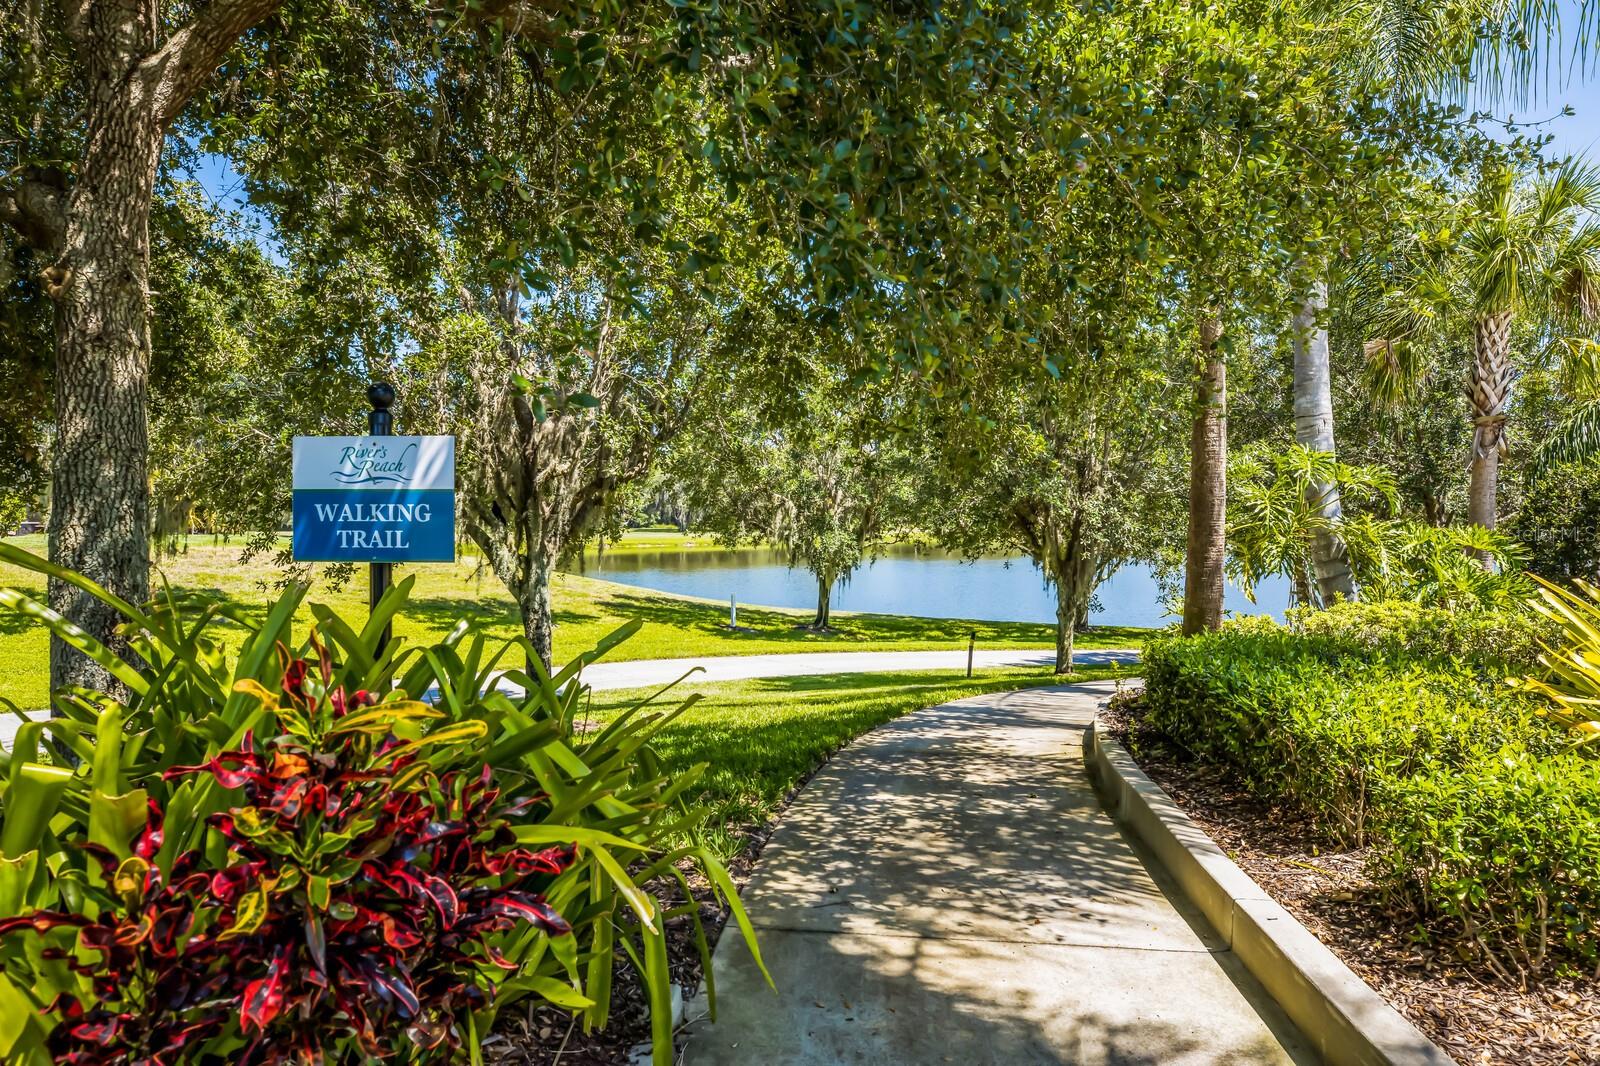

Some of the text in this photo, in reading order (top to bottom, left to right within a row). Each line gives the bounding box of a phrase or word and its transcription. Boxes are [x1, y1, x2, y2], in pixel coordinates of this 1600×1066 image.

[339, 443, 388, 470] River's
[358, 443, 417, 485] Reach
[314, 503, 432, 523] WALKING
[336, 529, 410, 549] TRAIL
